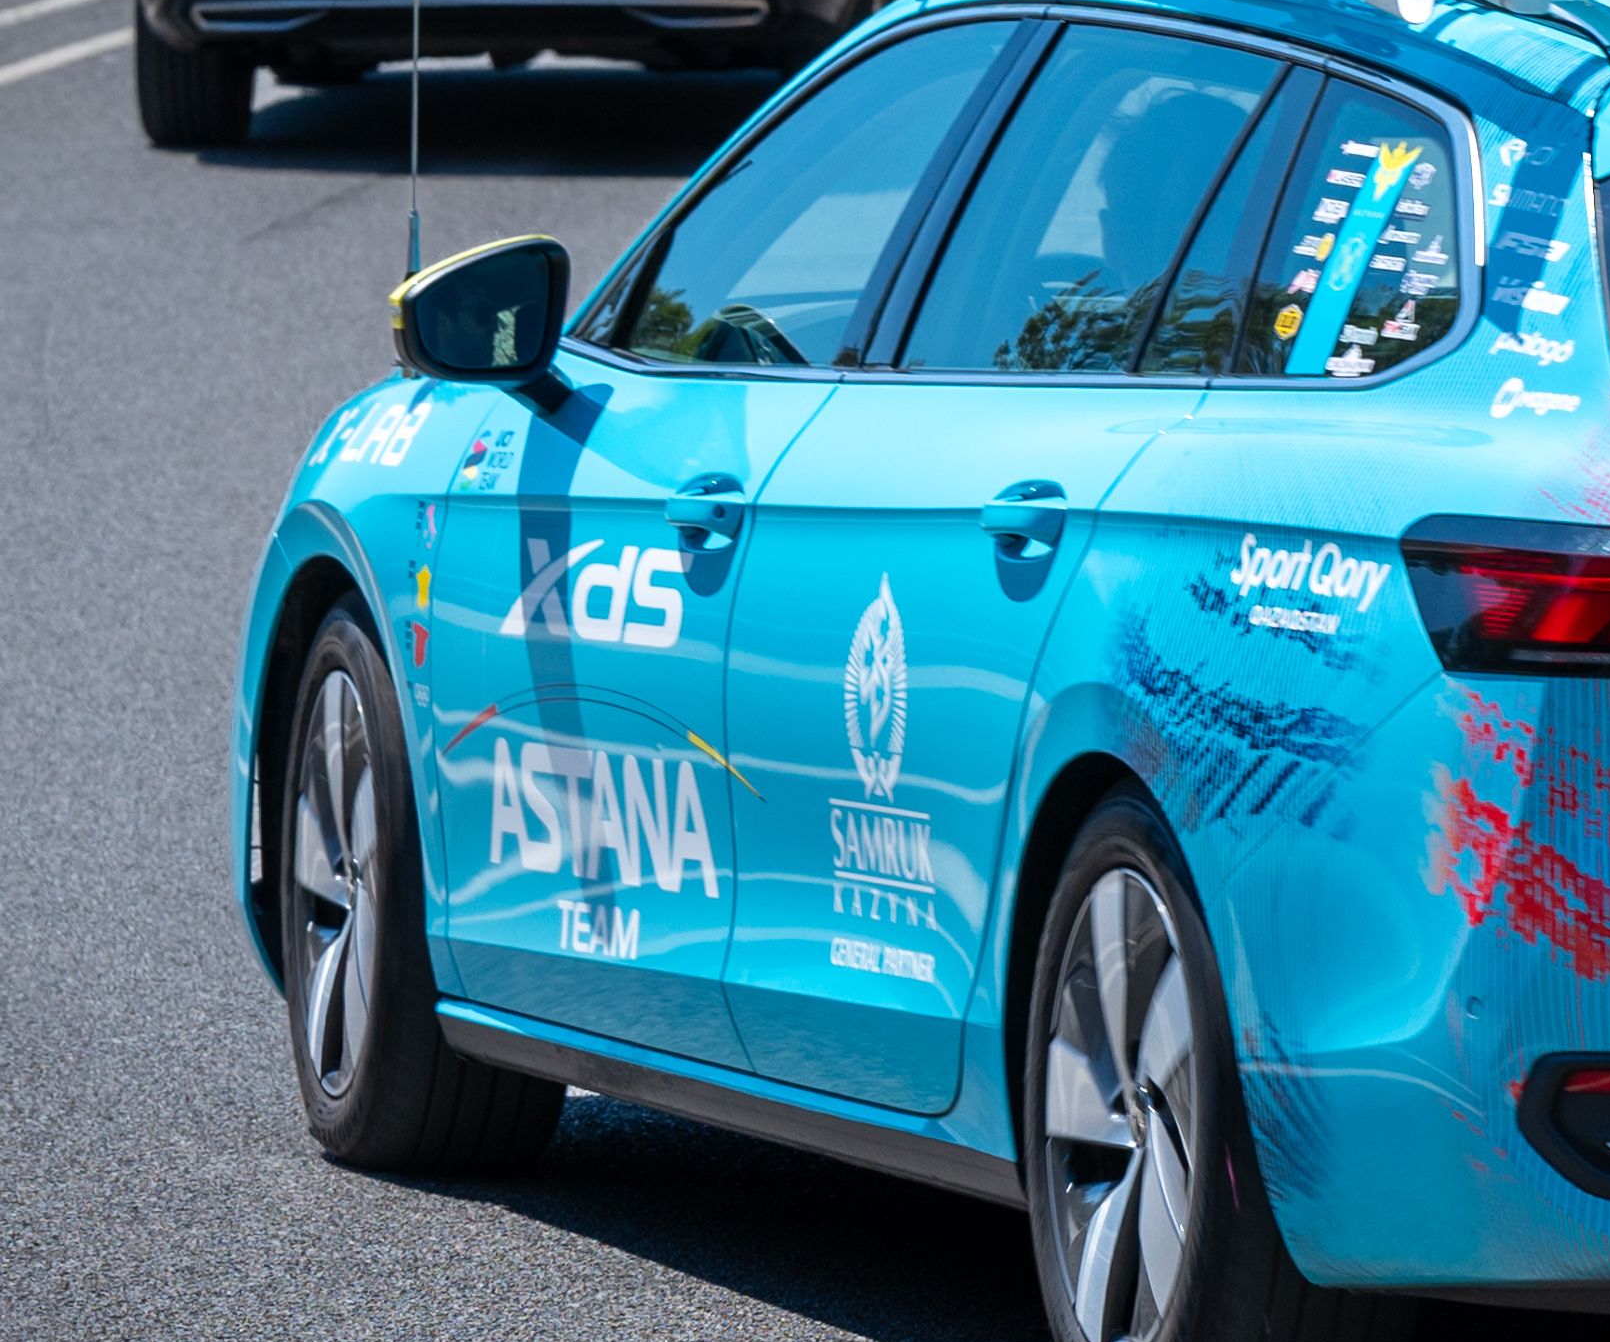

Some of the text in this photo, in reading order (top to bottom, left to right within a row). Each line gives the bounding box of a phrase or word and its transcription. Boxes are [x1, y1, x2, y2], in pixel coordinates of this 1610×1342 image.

[490, 736, 720, 899] ASTANA
[830, 807, 936, 884] SAMRUK
[558, 899, 641, 960] TEAM
[832, 882, 938, 932] KAZYNA
